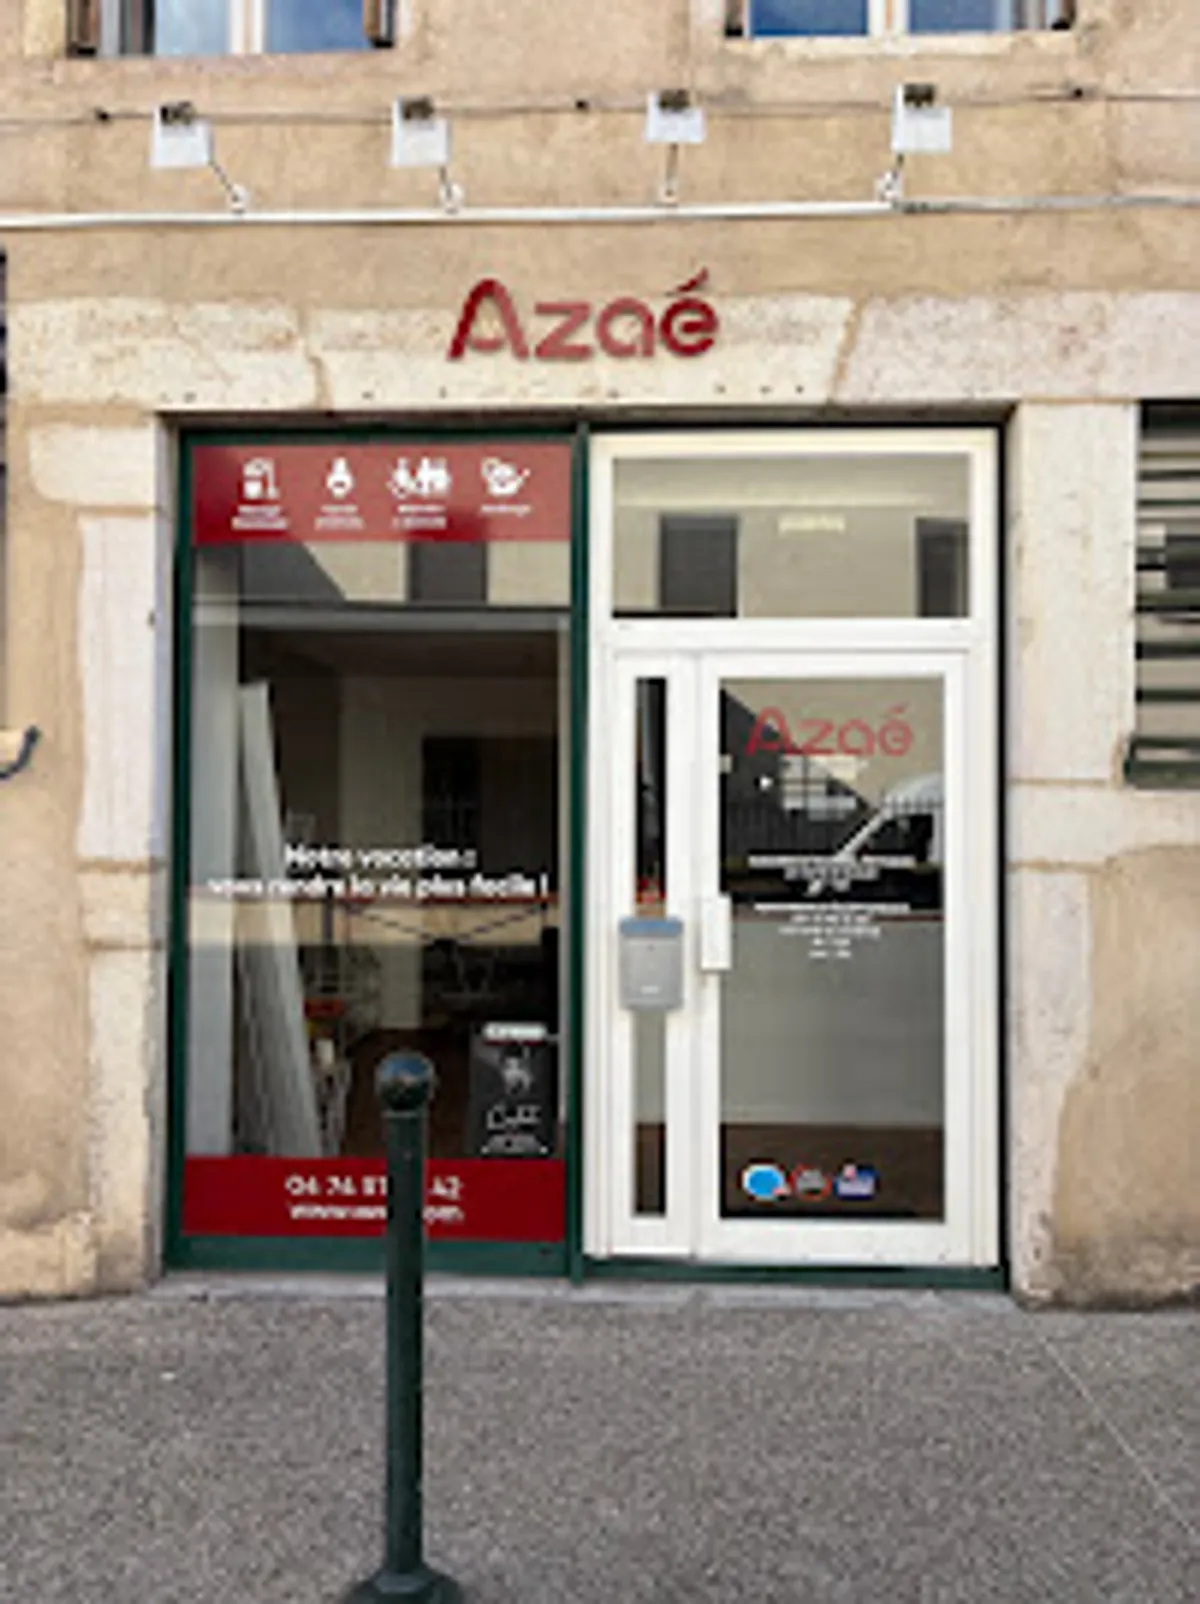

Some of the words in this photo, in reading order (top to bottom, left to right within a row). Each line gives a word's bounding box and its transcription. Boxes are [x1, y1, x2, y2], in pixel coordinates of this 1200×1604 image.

[447, 267, 719, 361] Azaé
[745, 703, 912, 757] Azaé
[285, 843, 351, 869] Notre
[355, 844, 461, 869] vocation
[268, 873, 346, 898] rendre
[416, 873, 465, 899] plus
[469, 873, 536, 898] facile
